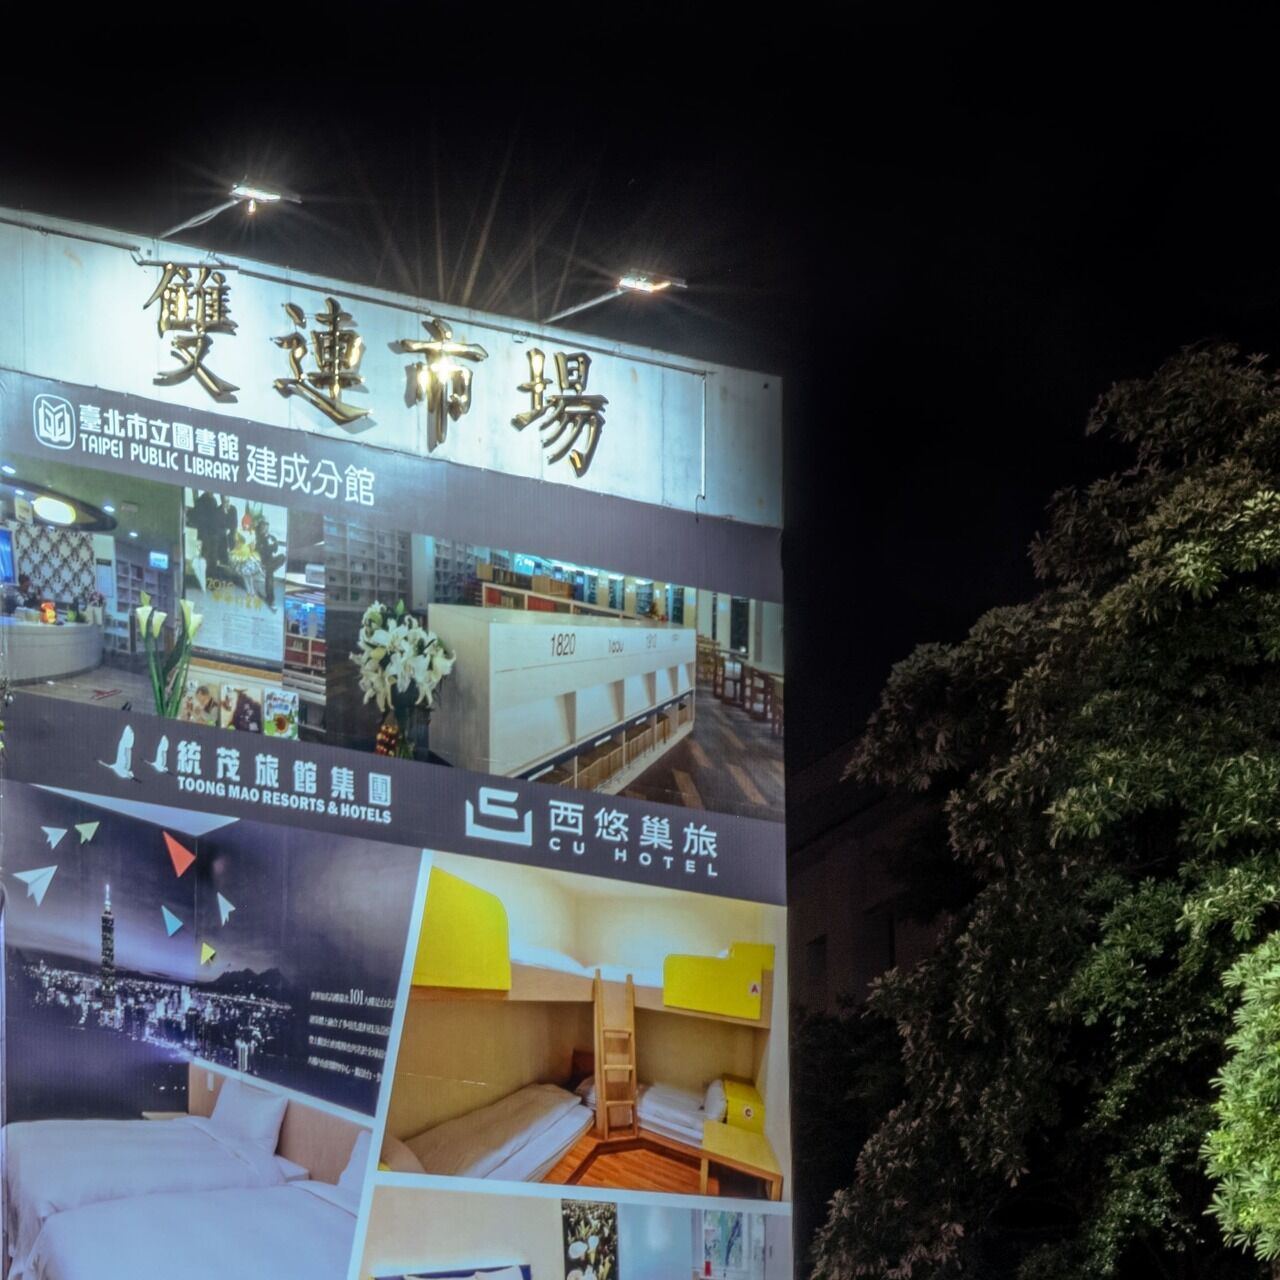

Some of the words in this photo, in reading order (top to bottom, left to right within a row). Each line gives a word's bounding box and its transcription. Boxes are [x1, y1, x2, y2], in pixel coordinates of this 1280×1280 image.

[143, 261, 609, 477] 雙連市場
[80, 405, 239, 462] 臺北市立圖書館
[80, 433, 123, 459] TAIPEI
[130, 443, 178, 471] PUBLIC
[184, 456, 239, 483] LIBRARY
[245, 444, 375, 507] 建成分館
[551, 633, 576, 656] 1820
[177, 740, 391, 806] 統茂旅館集團
[177, 776, 225, 797] TOONG
[228, 785, 260, 802] MAO
[262, 791, 325, 813] RESORTS
[327, 802, 338, 815] &
[341, 803, 391, 824] HOTELS
[548, 800, 718, 858] 西悠巢旅
[549, 838, 585, 855] CU
[615, 848, 718, 877] HOTEL
